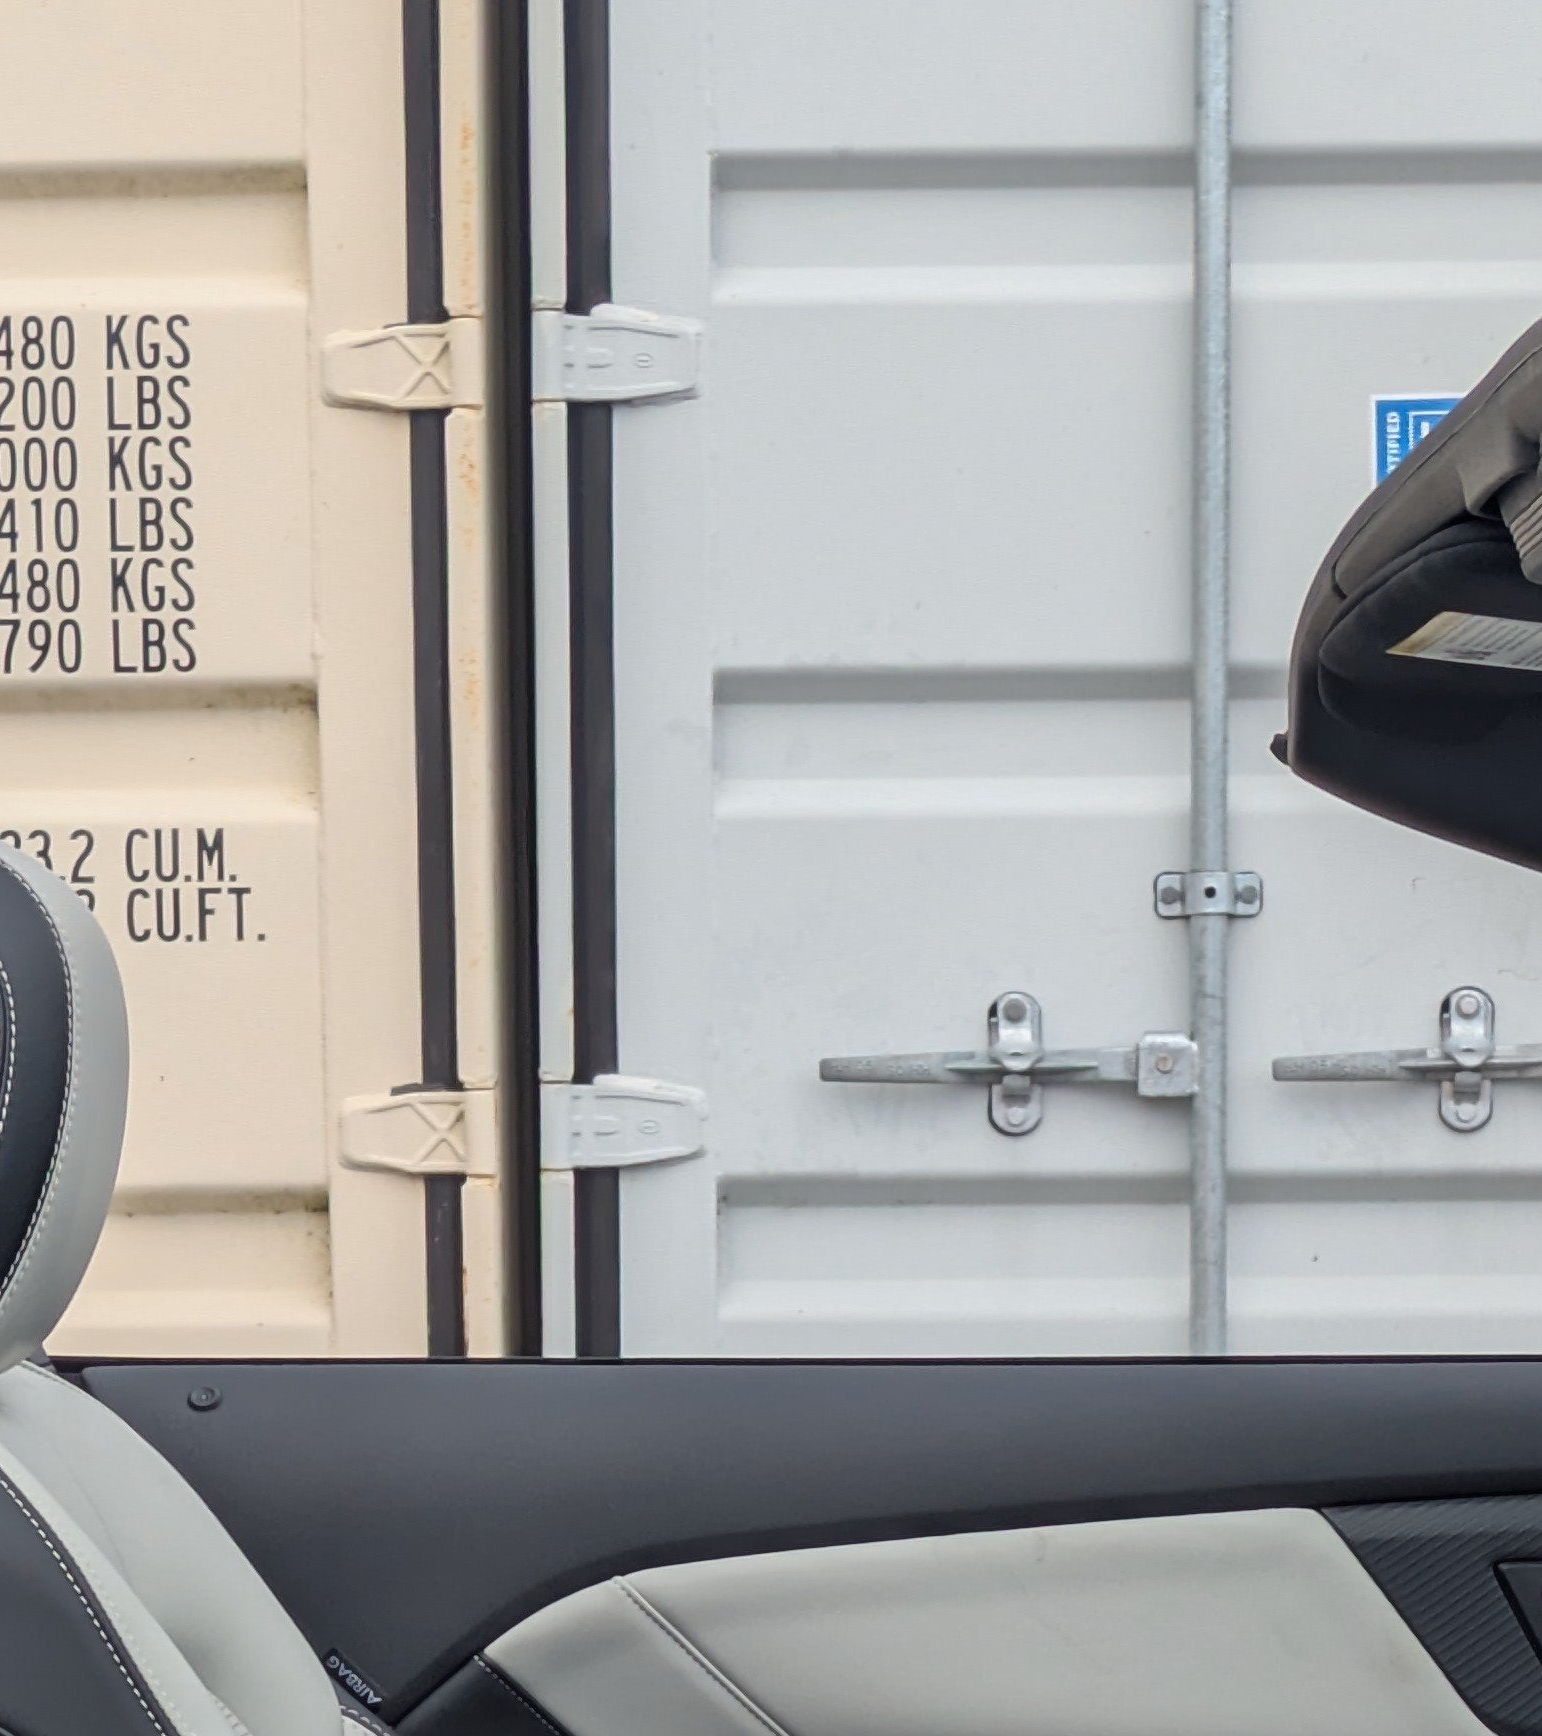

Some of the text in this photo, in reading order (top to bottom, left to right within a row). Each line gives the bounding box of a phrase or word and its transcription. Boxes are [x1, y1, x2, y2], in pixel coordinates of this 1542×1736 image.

[106, 314, 190, 370] KGS
[106, 375, 191, 431] LBS
[108, 435, 192, 491] KGS
[109, 497, 194, 552] LBS
[110, 557, 195, 613] KGS
[112, 618, 197, 673] LBS
[125, 828, 238, 883] CU.M.
[126, 887, 266, 942] CU.FT.
[326, 1655, 383, 1706] AIRBAG
